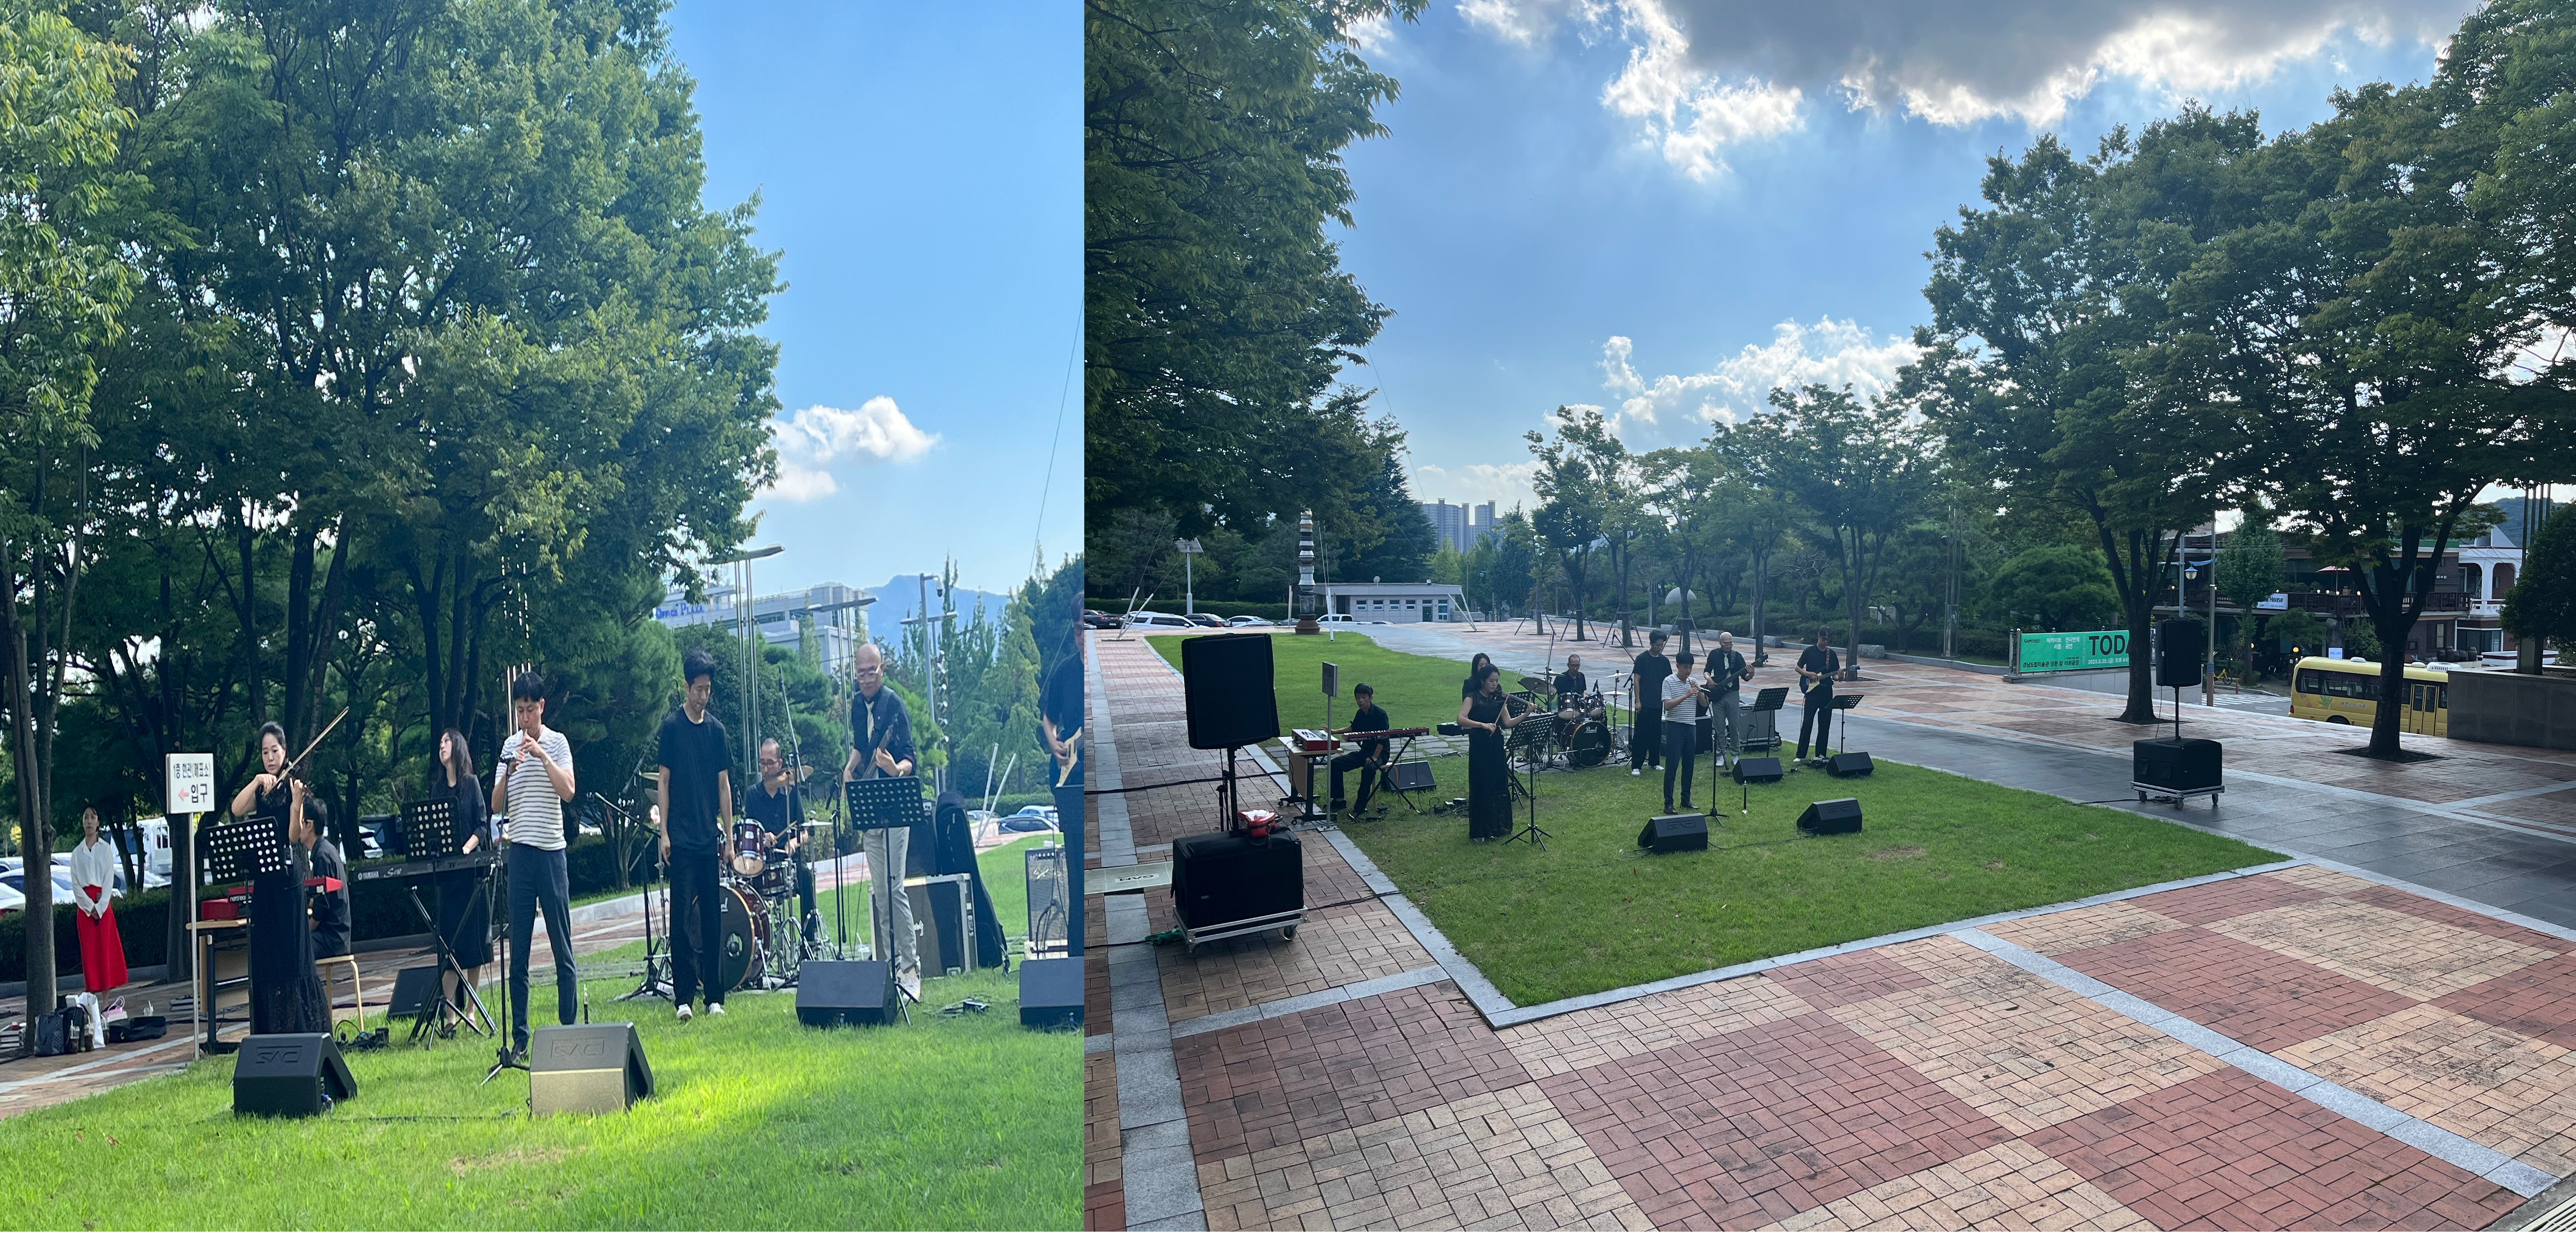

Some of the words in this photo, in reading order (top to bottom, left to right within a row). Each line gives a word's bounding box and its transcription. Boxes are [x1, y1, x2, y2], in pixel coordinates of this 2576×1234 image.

[2089, 635, 2129, 655] TOD
[191, 783, 207, 803] 입구
[363, 870, 379, 879] YAMAHA
